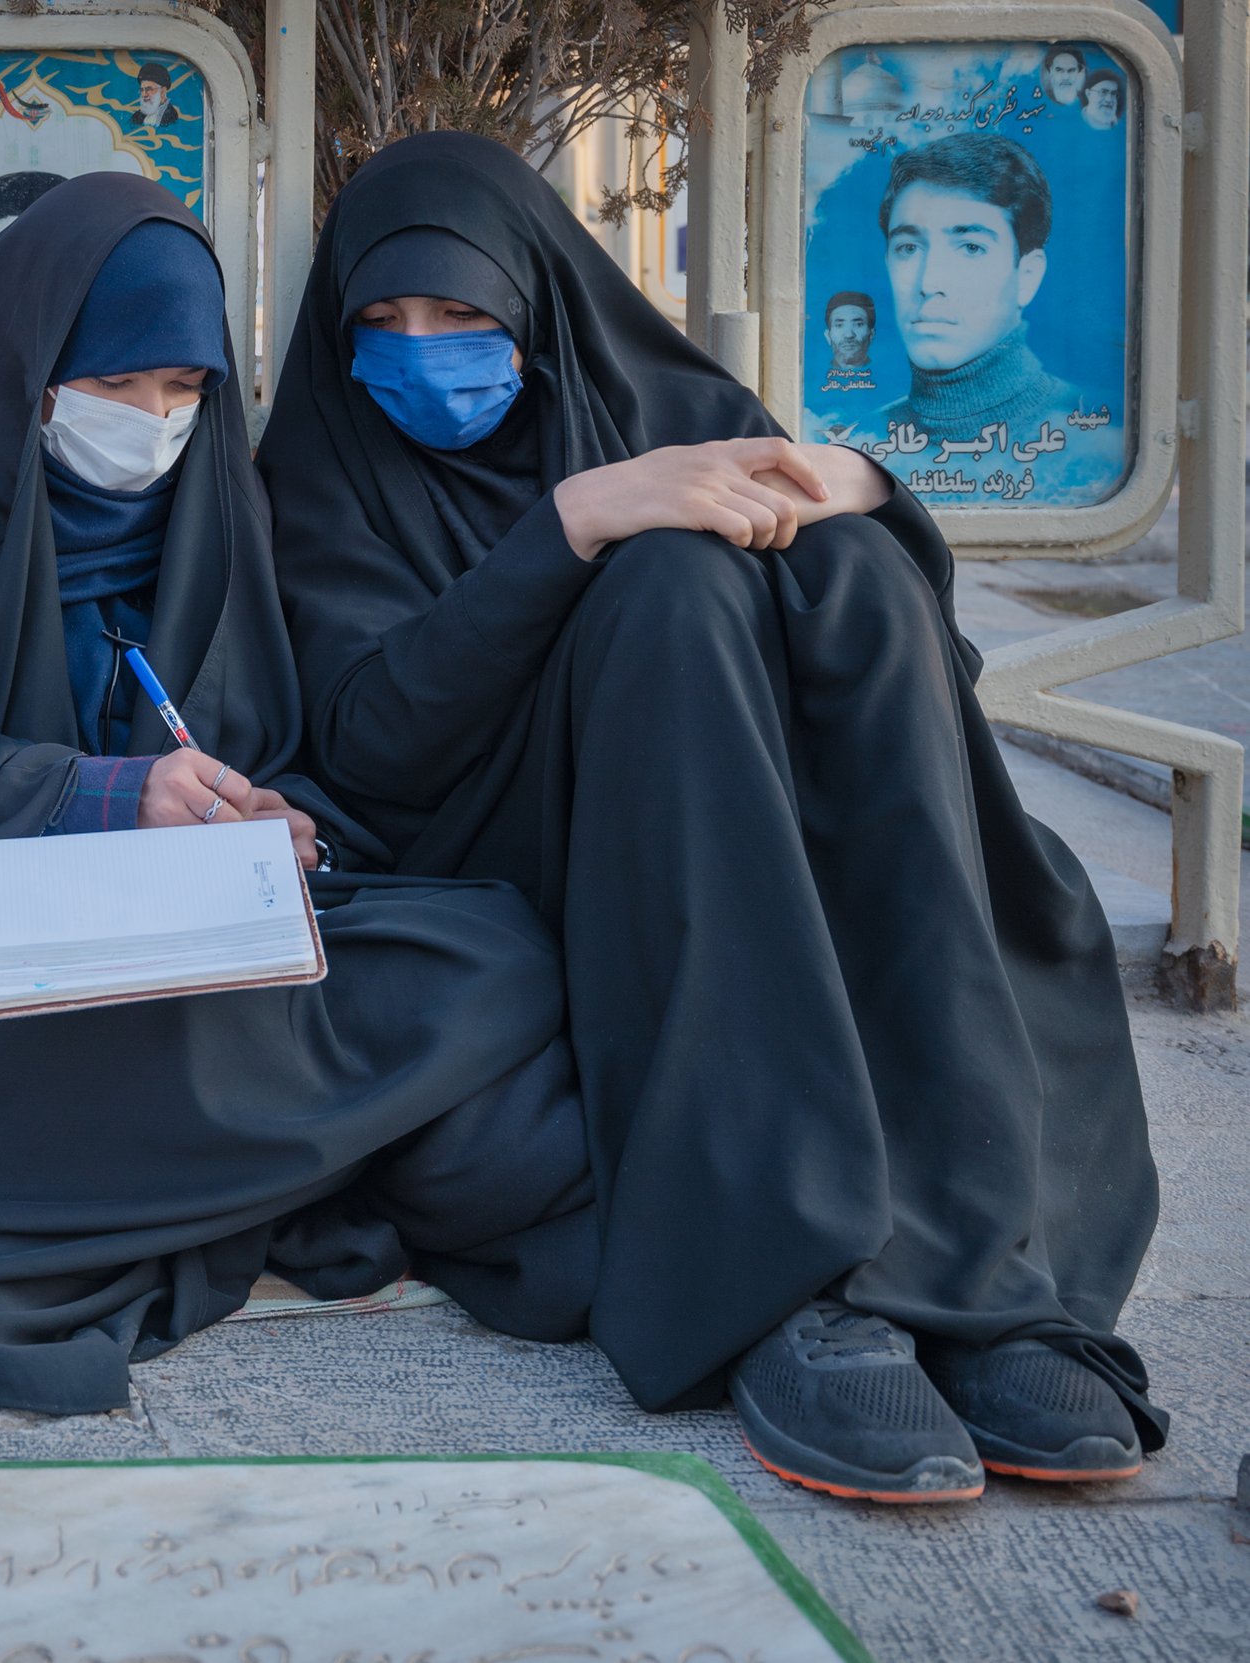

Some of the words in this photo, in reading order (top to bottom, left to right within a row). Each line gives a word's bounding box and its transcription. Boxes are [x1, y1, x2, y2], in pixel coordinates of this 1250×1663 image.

[895, 103, 921, 121] الله
[993, 86, 1018, 125] نظر
[1018, 86, 1046, 133] شهید
[1067, 405, 1111, 430] شهید
[933, 421, 1009, 463] اکبر
[1012, 421, 1066, 463] علی
[907, 469, 976, 494] سلطانعل
[983, 468, 1035, 500] فرزند
